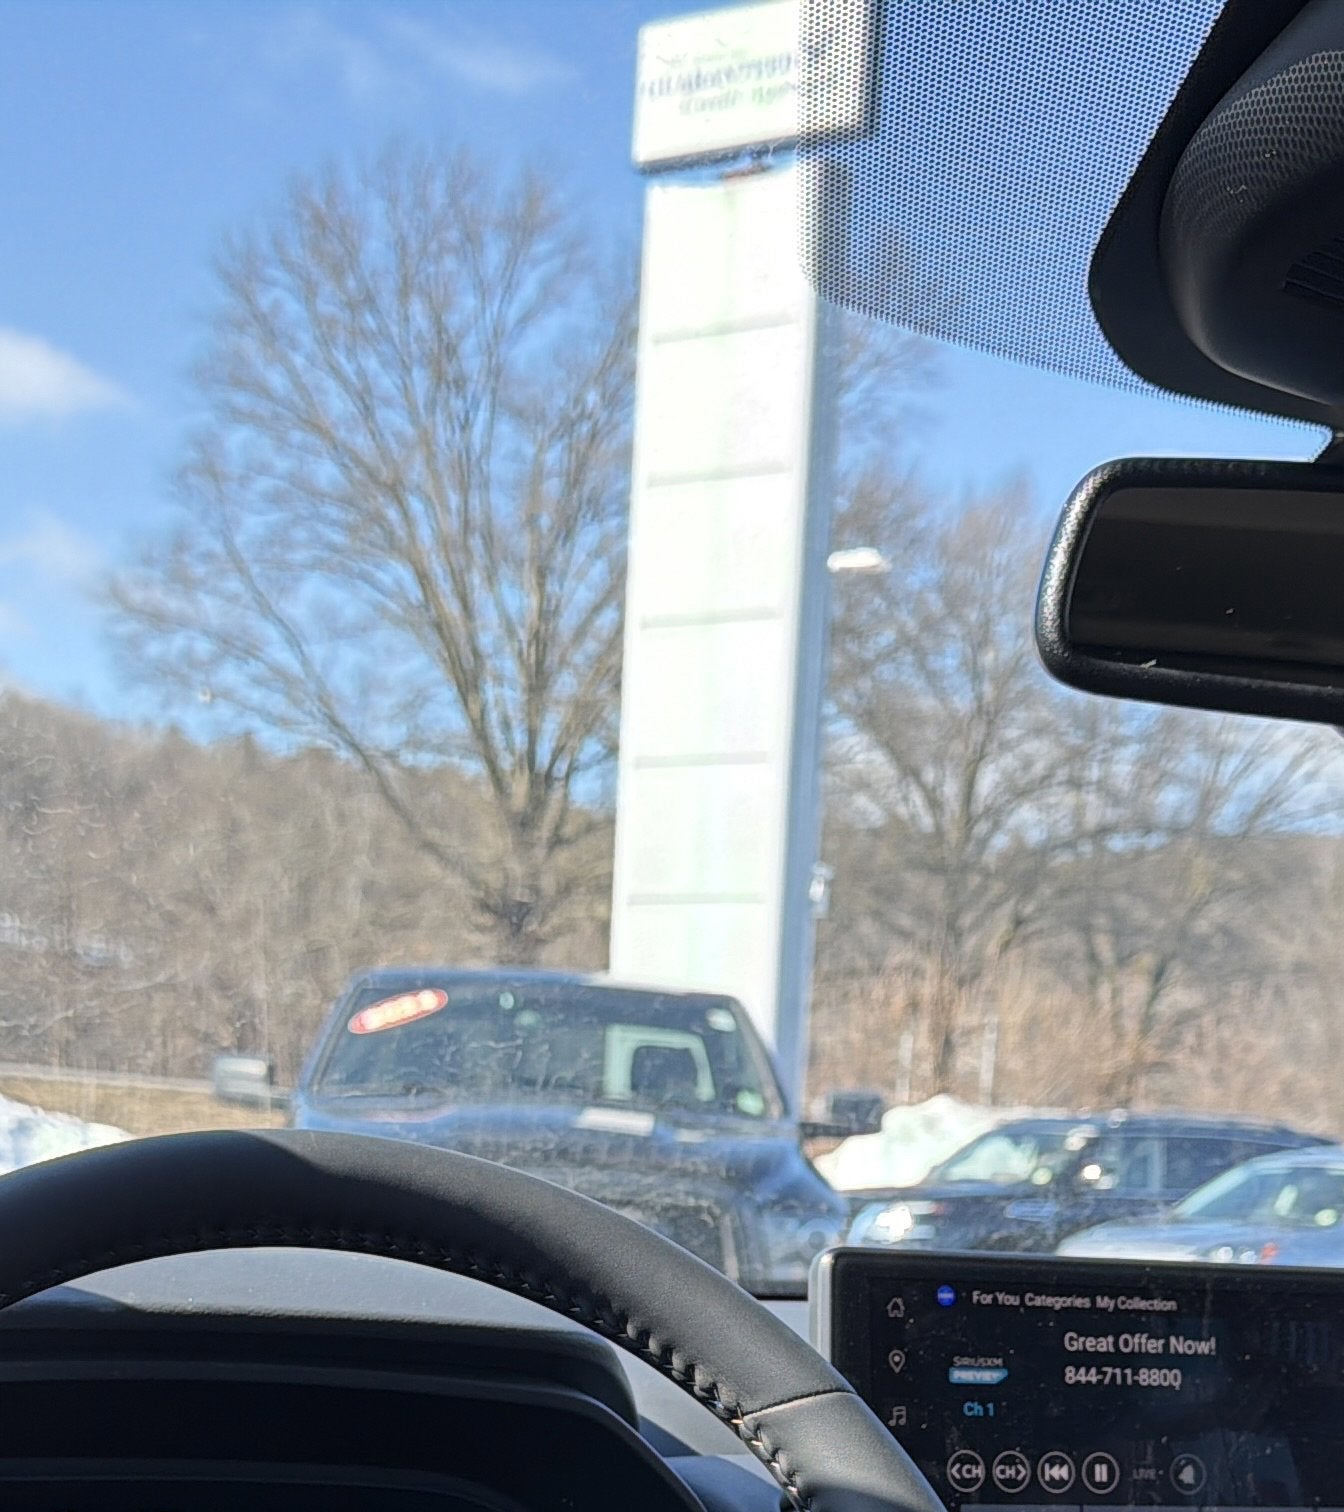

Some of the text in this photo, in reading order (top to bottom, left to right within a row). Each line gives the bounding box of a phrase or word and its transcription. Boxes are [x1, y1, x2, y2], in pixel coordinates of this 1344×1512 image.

[972, 1290, 993, 1305] For
[995, 1291, 1020, 1306] You
[1024, 1292, 1091, 1310] Categories
[1095, 1295, 1116, 1312] My
[1117, 1296, 1178, 1312] Collection
[1064, 1332, 1216, 1356] Great Offer Now!
[1064, 1366, 1182, 1387] 844-711-8800
[963, 1401, 994, 1417] Ch 1
[962, 1463, 982, 1480] CH
[995, 1464, 1016, 1480] CH
